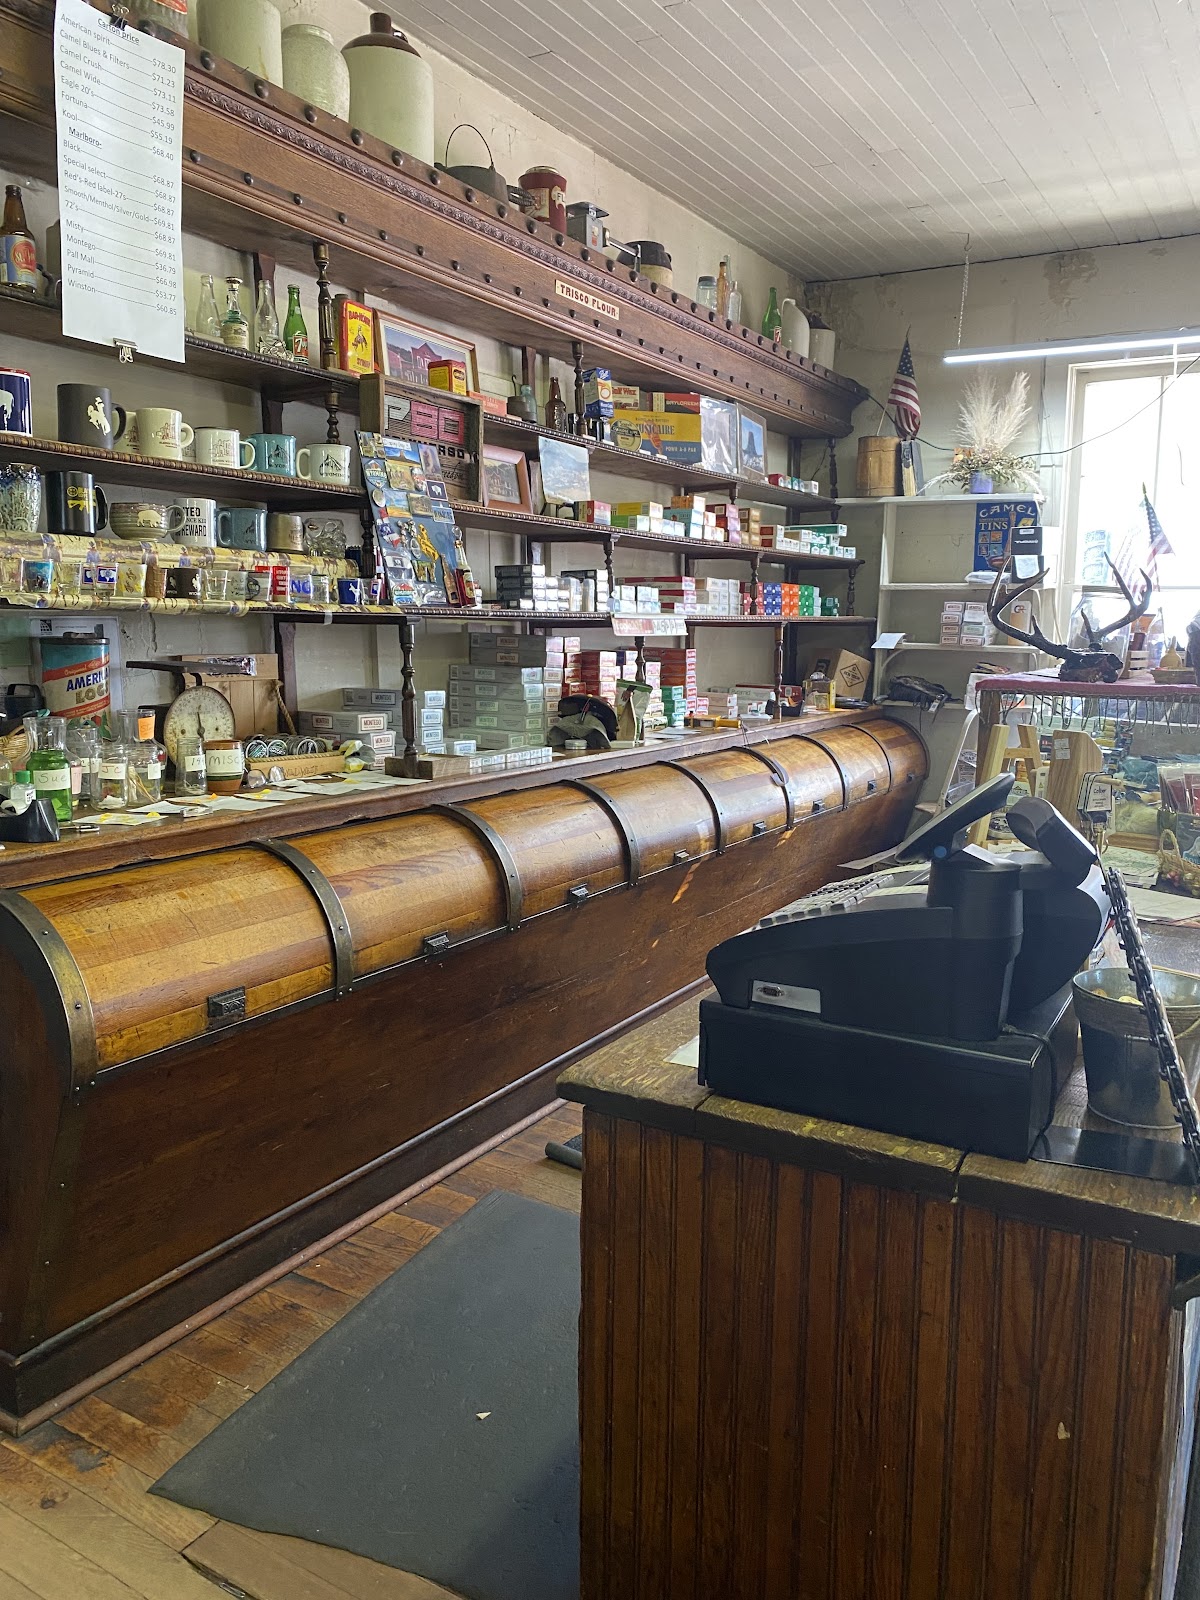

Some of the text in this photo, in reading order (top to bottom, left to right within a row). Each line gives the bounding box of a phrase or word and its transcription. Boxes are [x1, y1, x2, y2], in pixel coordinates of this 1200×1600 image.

[98, 18, 139, 44] Carton price
[61, 14, 92, 34] American
[152, 58, 176, 73] $78.30
[60, 29, 81, 46] Camel
[83, 39, 101, 55] Blues
[110, 54, 130, 70] Filters
[151, 73, 175, 88] $71.23
[60, 61, 81, 76] Camel
[84, 70, 101, 84] Wide
[60, 45, 176, 103] Camel Crush $73.11
[61, 75, 78, 91] Eagle
[62, 91, 88, 109] Fortuna
[62, 109, 77, 121] Kool
[64, 139, 81, 152] Black
[64, 155, 86, 171] Special
[88, 164, 106, 179] select
[66, 218, 84, 233] Misty
[66, 234, 96, 251] Montego
[67, 249, 79, 260] Pall
[80, 253, 95, 264] Mall
[68, 264, 94, 279] Pyramid
[68, 279, 96, 293] Winston
[560, 284, 616, 316] TRISCO FLOUR
[636, 424, 674, 434] USICAIRE
[979, 504, 1036, 518] CAMEL
[979, 521, 1008, 531] TINS
